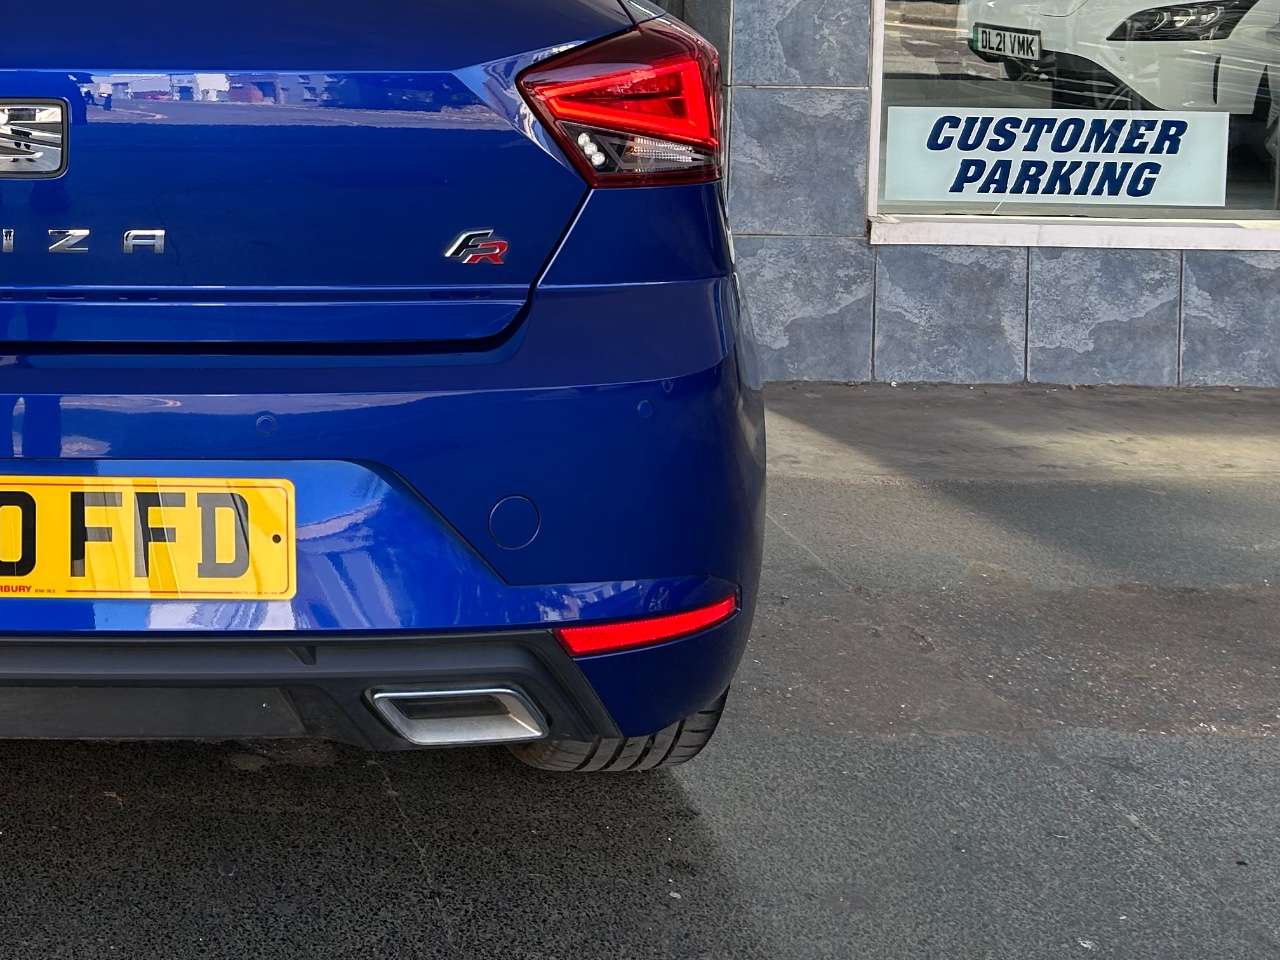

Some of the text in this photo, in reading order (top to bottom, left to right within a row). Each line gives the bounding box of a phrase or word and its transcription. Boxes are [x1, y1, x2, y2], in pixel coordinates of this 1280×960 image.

[981, 30, 1035, 57] DL21 VMK
[927, 115, 1188, 155] CUSTOMER
[949, 159, 1162, 198] PARKING
[444, 229, 509, 265] FR
[70, 490, 250, 579] FFD
